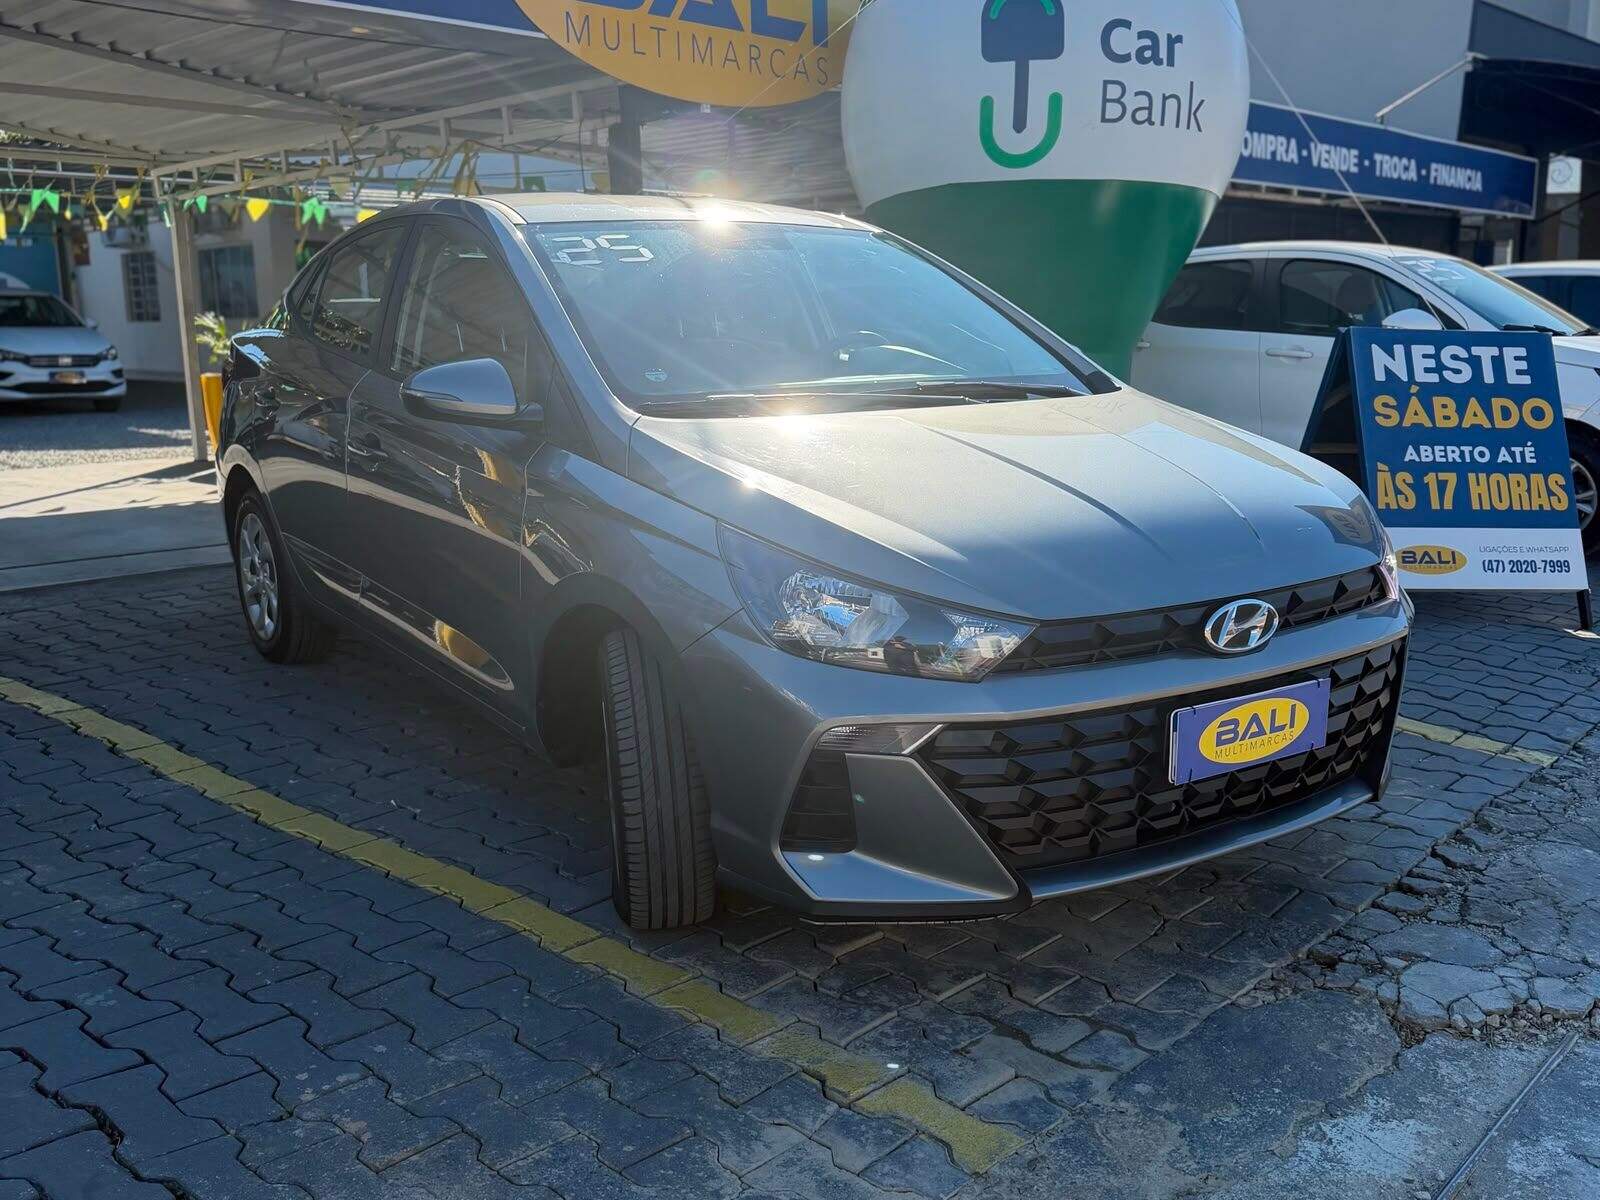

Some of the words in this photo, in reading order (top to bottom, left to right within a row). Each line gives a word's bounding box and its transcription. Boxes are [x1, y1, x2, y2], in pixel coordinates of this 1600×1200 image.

[564, 10, 830, 87] MULTIMARCAS
[1099, 18, 1184, 68] Car
[1099, 79, 1206, 133] Bank
[1241, 131, 1299, 165] OMPRA
[1309, 142, 1359, 173] VENDE
[1373, 153, 1418, 182] TROCA
[1429, 162, 1483, 192] FINANCIA
[551, 234, 655, 266] 25
[1371, 344, 1532, 385] NESTE
[1373, 385, 1555, 430] SÁBADO
[1404, 445, 1491, 464] ABERTO
[1496, 442, 1537, 464] ATÉ
[1376, 462, 1417, 511] ÀS
[1423, 473, 1458, 511] 17
[1467, 473, 1569, 512] HORAS
[1401, 550, 1457, 565] BALI
[1482, 559, 1506, 574] (47)
[1508, 559, 1571, 574] 2020-7999
[1214, 730, 1295, 760] MULTIMARCAS
[1215, 703, 1297, 748] BALI
